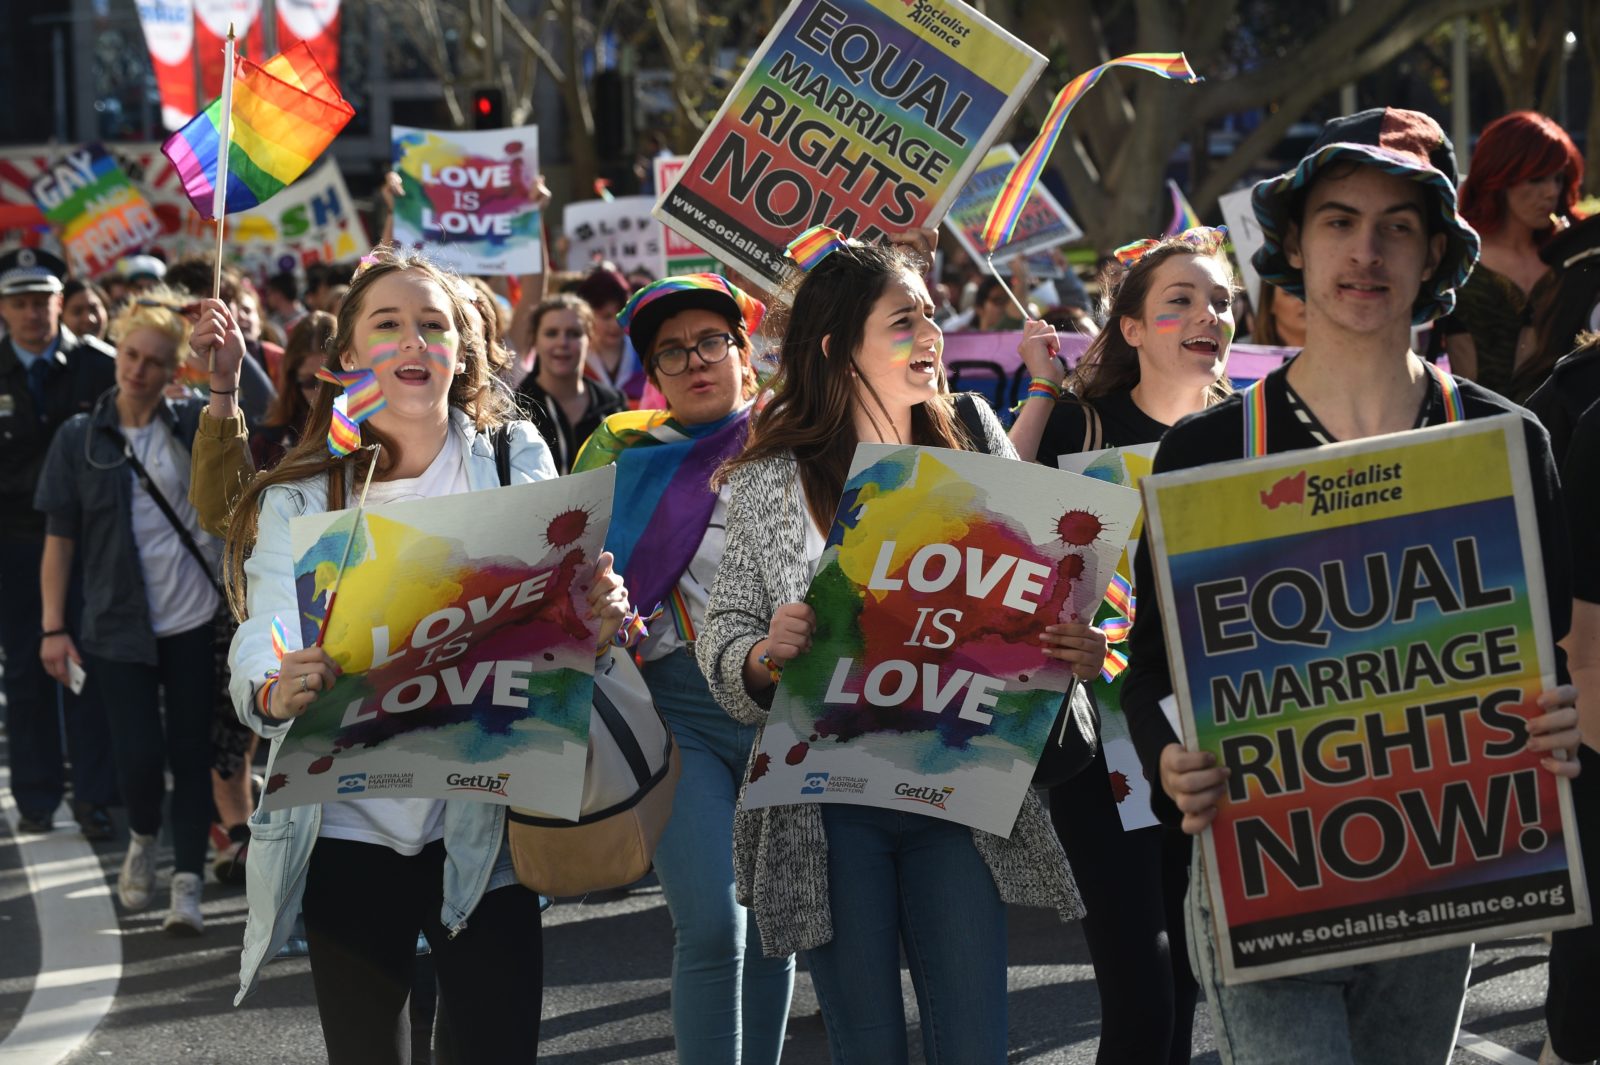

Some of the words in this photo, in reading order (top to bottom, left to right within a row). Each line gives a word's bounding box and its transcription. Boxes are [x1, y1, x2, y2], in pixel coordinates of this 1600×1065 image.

[907, 9, 961, 48] Alliance
[914, 0, 971, 38] Socialist
[796, 0, 973, 148] EQUAL
[768, 50, 951, 185] MARRIAGE
[33, 150, 98, 209] GAY
[421, 163, 511, 189] LOVE
[702, 131, 893, 247] NOW
[740, 85, 926, 226] RIGHTS
[421, 208, 512, 236] LOVE
[453, 190, 480, 211] IS
[69, 207, 161, 276] PROUD
[1306, 462, 1403, 498] Socialist
[1310, 484, 1403, 517] Alliance
[868, 540, 1052, 615] LOVE
[1195, 536, 1514, 656] EQUAL
[370, 570, 553, 670] LOVE
[415, 631, 473, 670] IS
[903, 607, 963, 649] IS
[340, 660, 533, 728] LOVE
[823, 657, 1007, 726] LOVE
[1210, 626, 1522, 726] MARRIAGE
[368, 772, 414, 780] AUSTRALIAN
[830, 775, 869, 783] AUSTRALIAN
[1221, 688, 1531, 804] RIGHTS
[827, 781, 867, 789] MARRIAGE
[1233, 769, 1548, 900] NOW!
[1237, 884, 1566, 956] www.socialist-alliance.org
